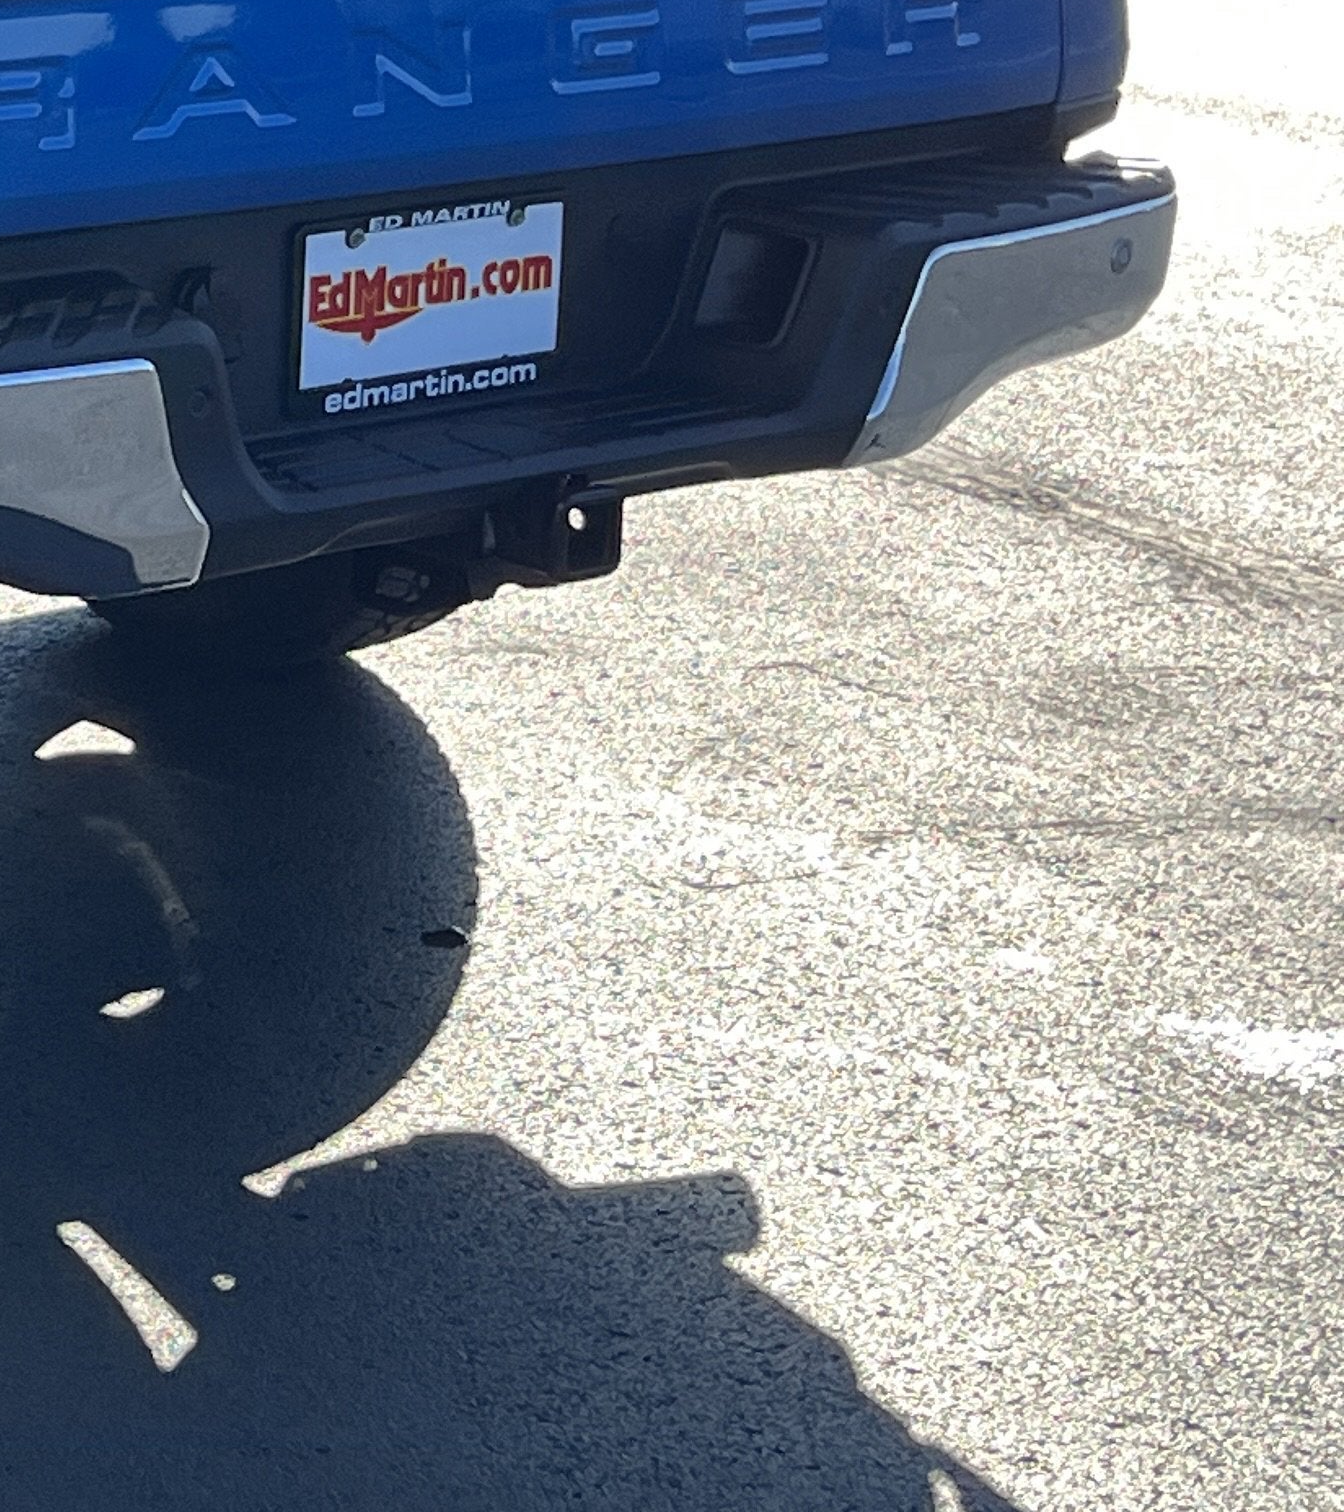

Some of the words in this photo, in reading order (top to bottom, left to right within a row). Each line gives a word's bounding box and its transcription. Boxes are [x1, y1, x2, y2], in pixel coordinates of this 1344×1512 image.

[369, 216, 403, 233] ED
[412, 199, 511, 226] MARTIN
[308, 254, 553, 323] EdMartin.com
[324, 361, 537, 414] edmartin.com
